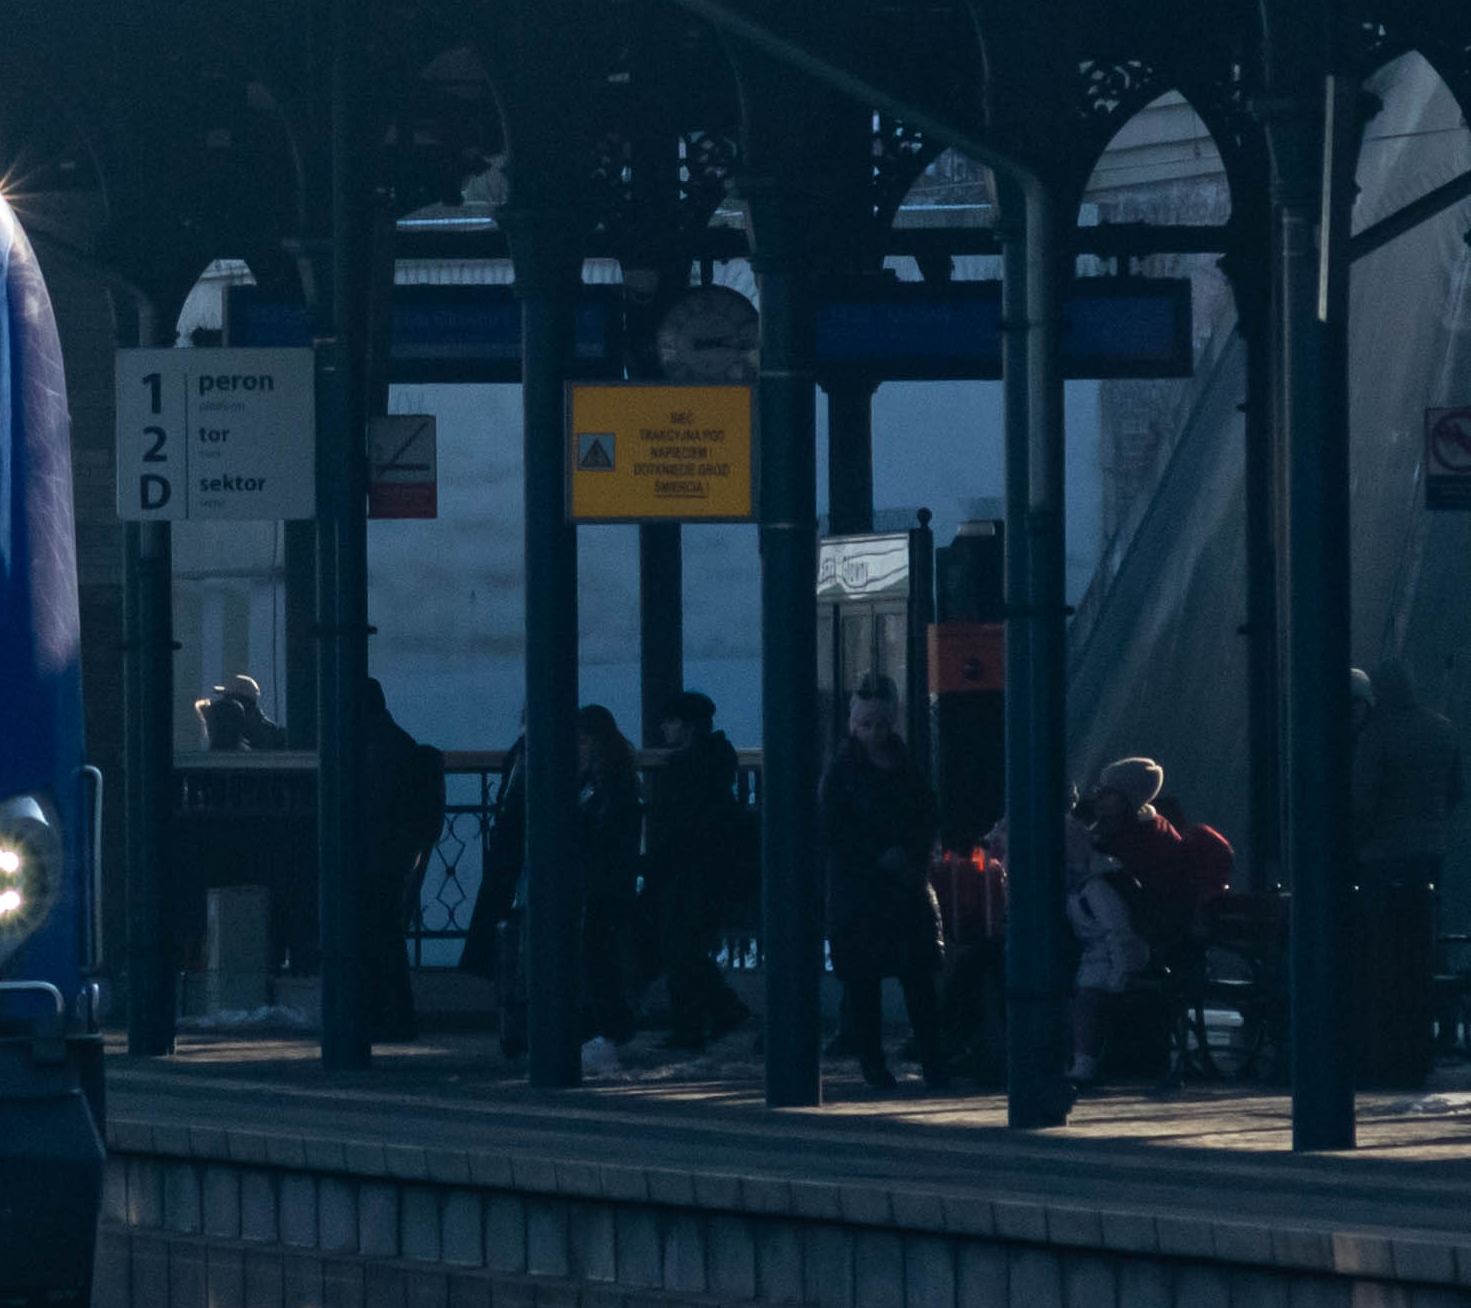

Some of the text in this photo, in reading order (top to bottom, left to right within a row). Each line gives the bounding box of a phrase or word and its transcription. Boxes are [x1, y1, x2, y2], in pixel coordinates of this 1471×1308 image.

[141, 372, 162, 414] 1
[198, 374, 275, 396] peron
[142, 425, 168, 462] 2
[198, 427, 230, 442] tor
[139, 474, 172, 510] D
[199, 473, 266, 492] sektor
